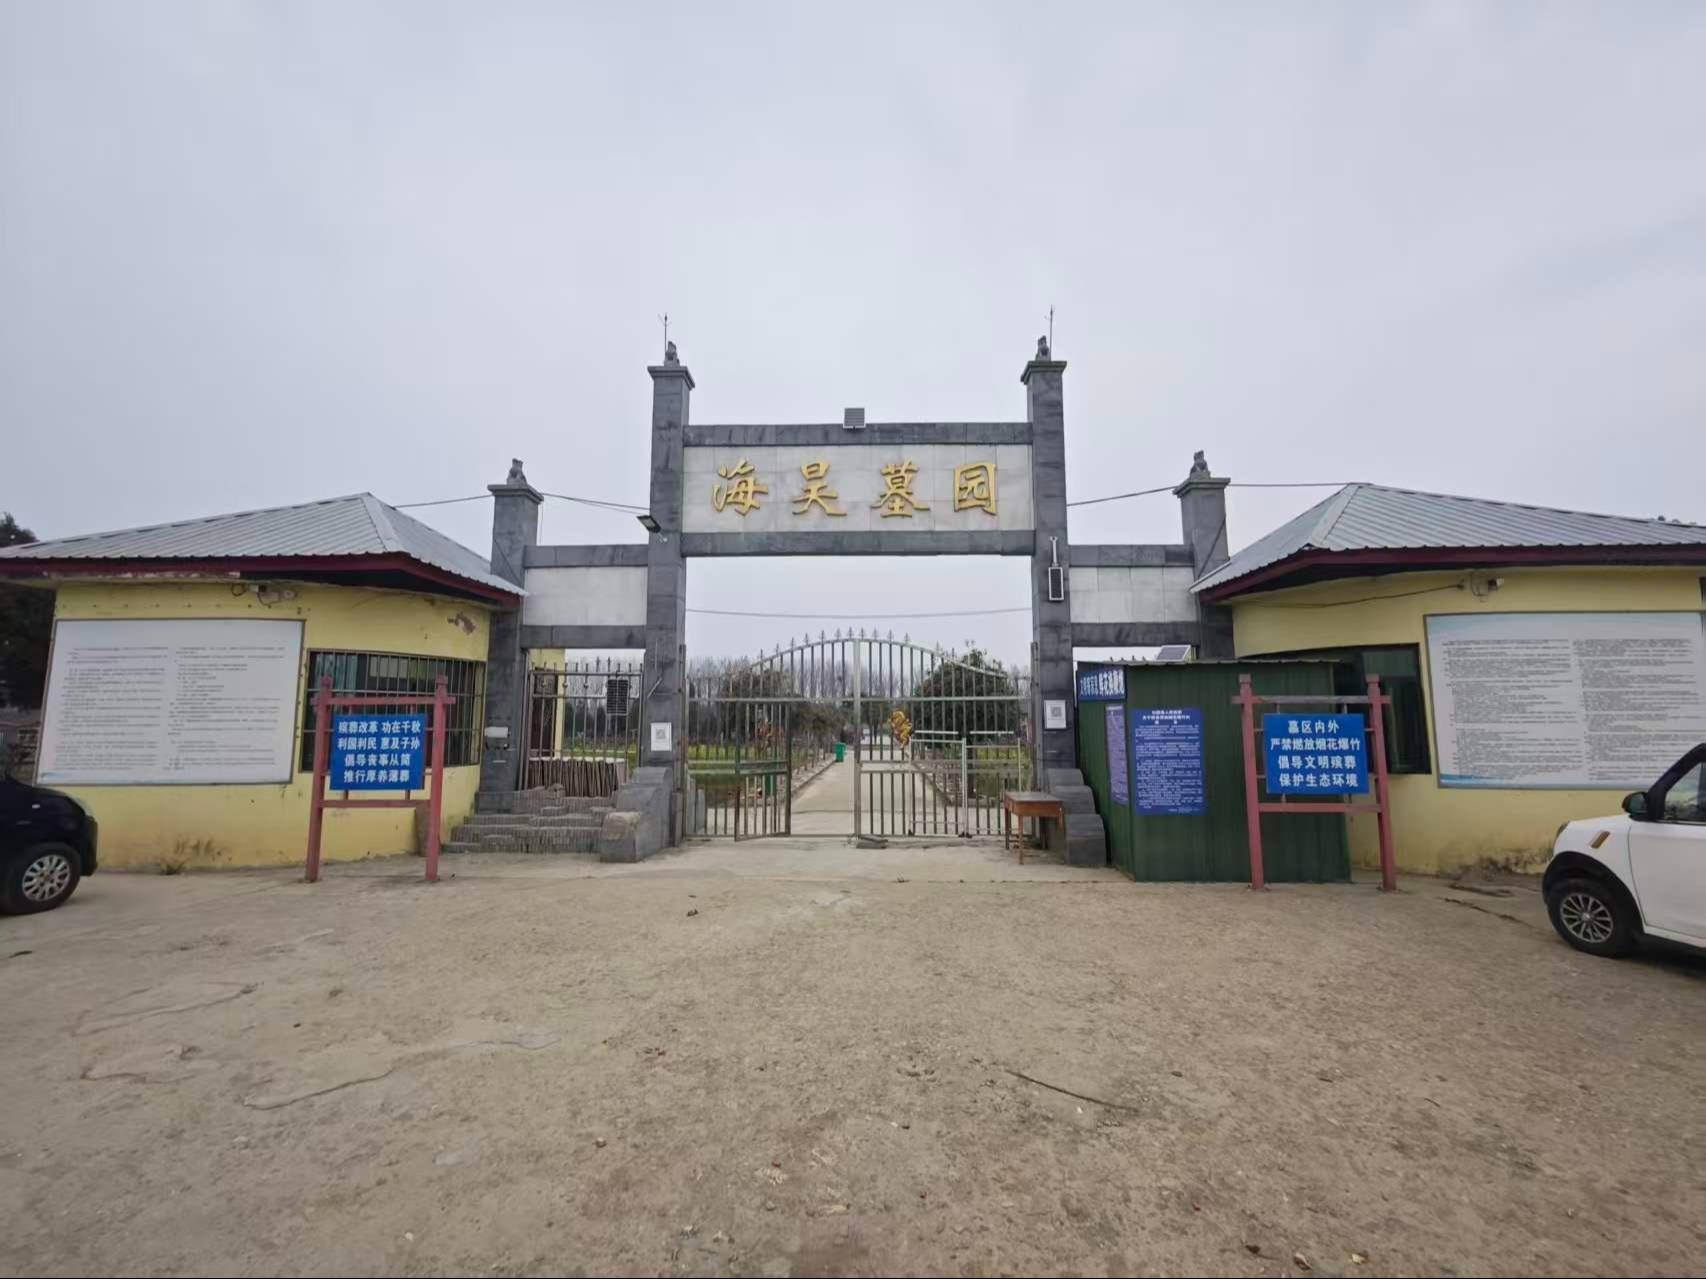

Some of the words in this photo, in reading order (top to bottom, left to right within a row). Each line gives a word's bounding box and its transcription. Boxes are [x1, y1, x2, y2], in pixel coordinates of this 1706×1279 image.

[712, 456, 998, 518] 海昊墓园
[382, 720, 421, 734] 功在千秋
[1288, 720, 1340, 734] 墓区内外
[337, 737, 377, 750] 利国利民
[1280, 773, 1358, 787] 保护生态环境
